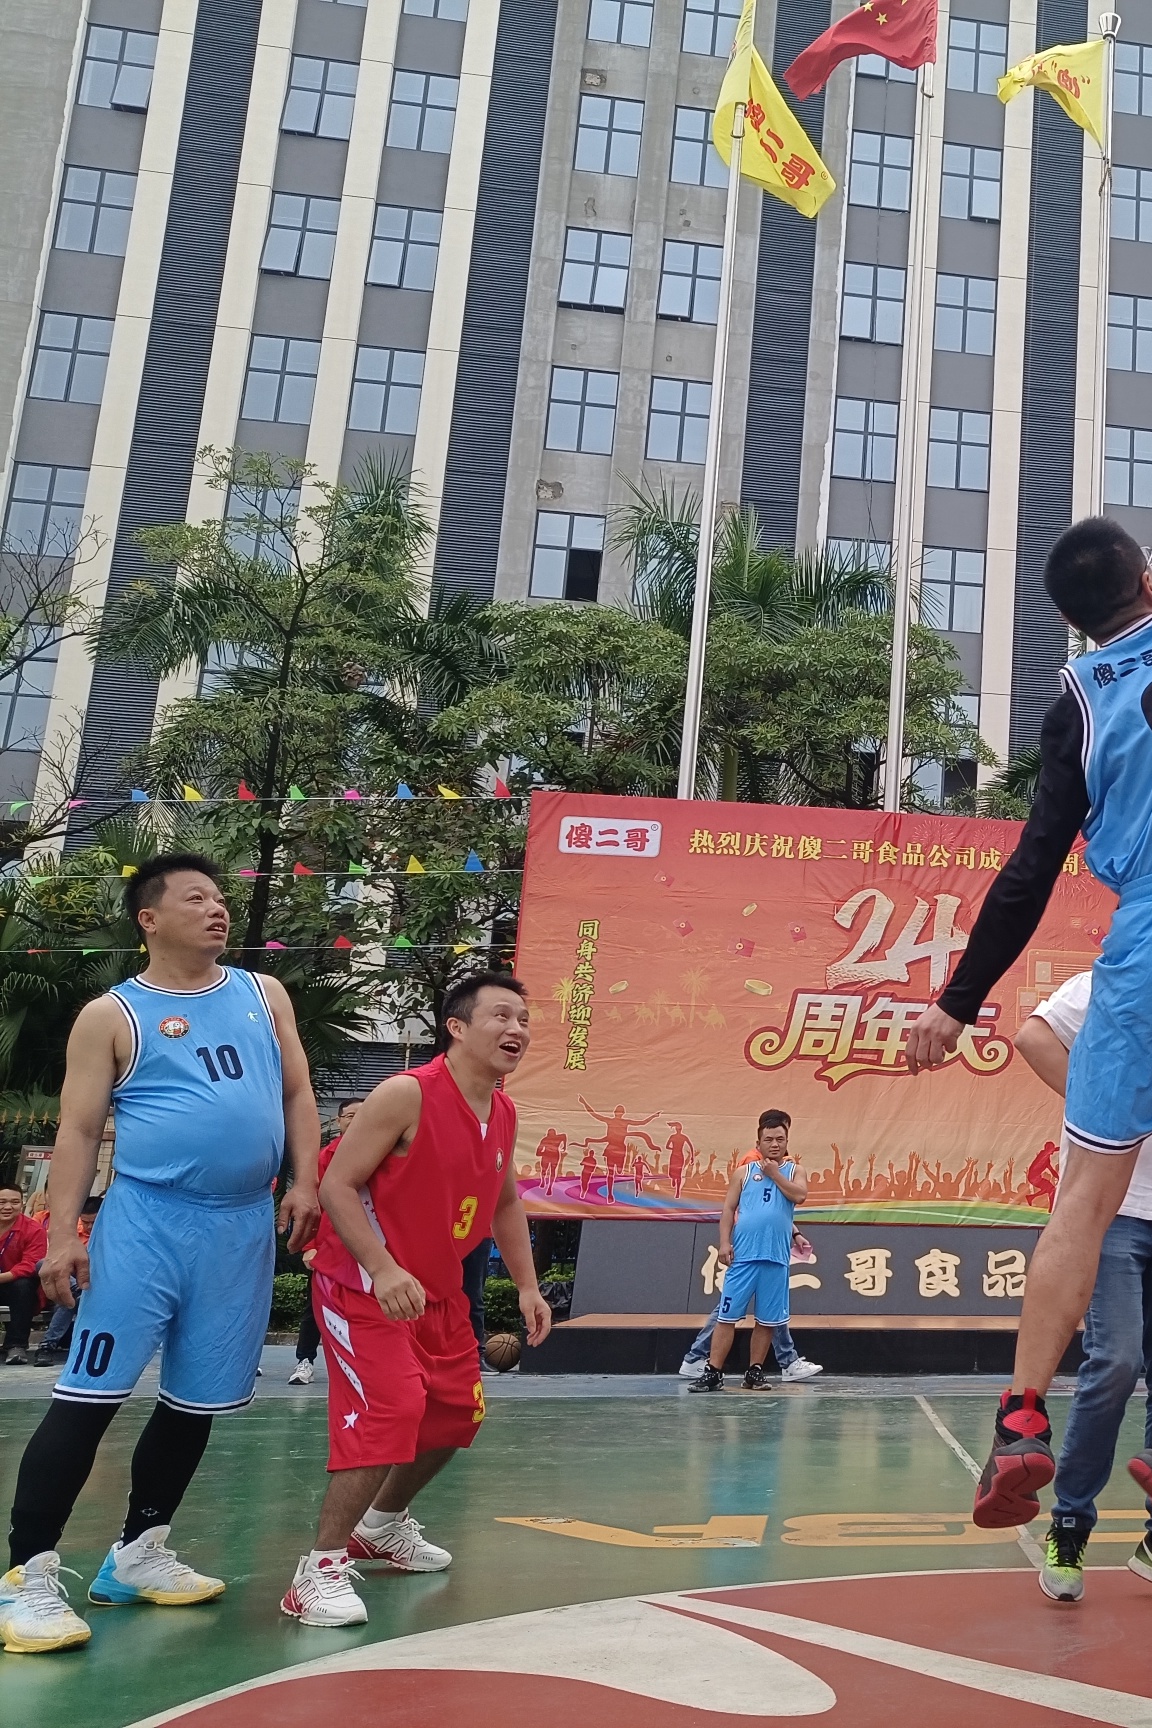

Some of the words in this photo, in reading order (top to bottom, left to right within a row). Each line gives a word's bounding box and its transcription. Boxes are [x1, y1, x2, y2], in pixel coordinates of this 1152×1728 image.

[565, 823, 650, 851] 傻二哥
[826, 888, 970, 995] 24
[196, 1044, 243, 1082] 10
[763, 1188, 772, 1203] 5
[452, 1195, 479, 1240] 3
[721, 1296, 733, 1314] 5
[71, 1328, 116, 1378] 10
[471, 1380, 486, 1424] 3
